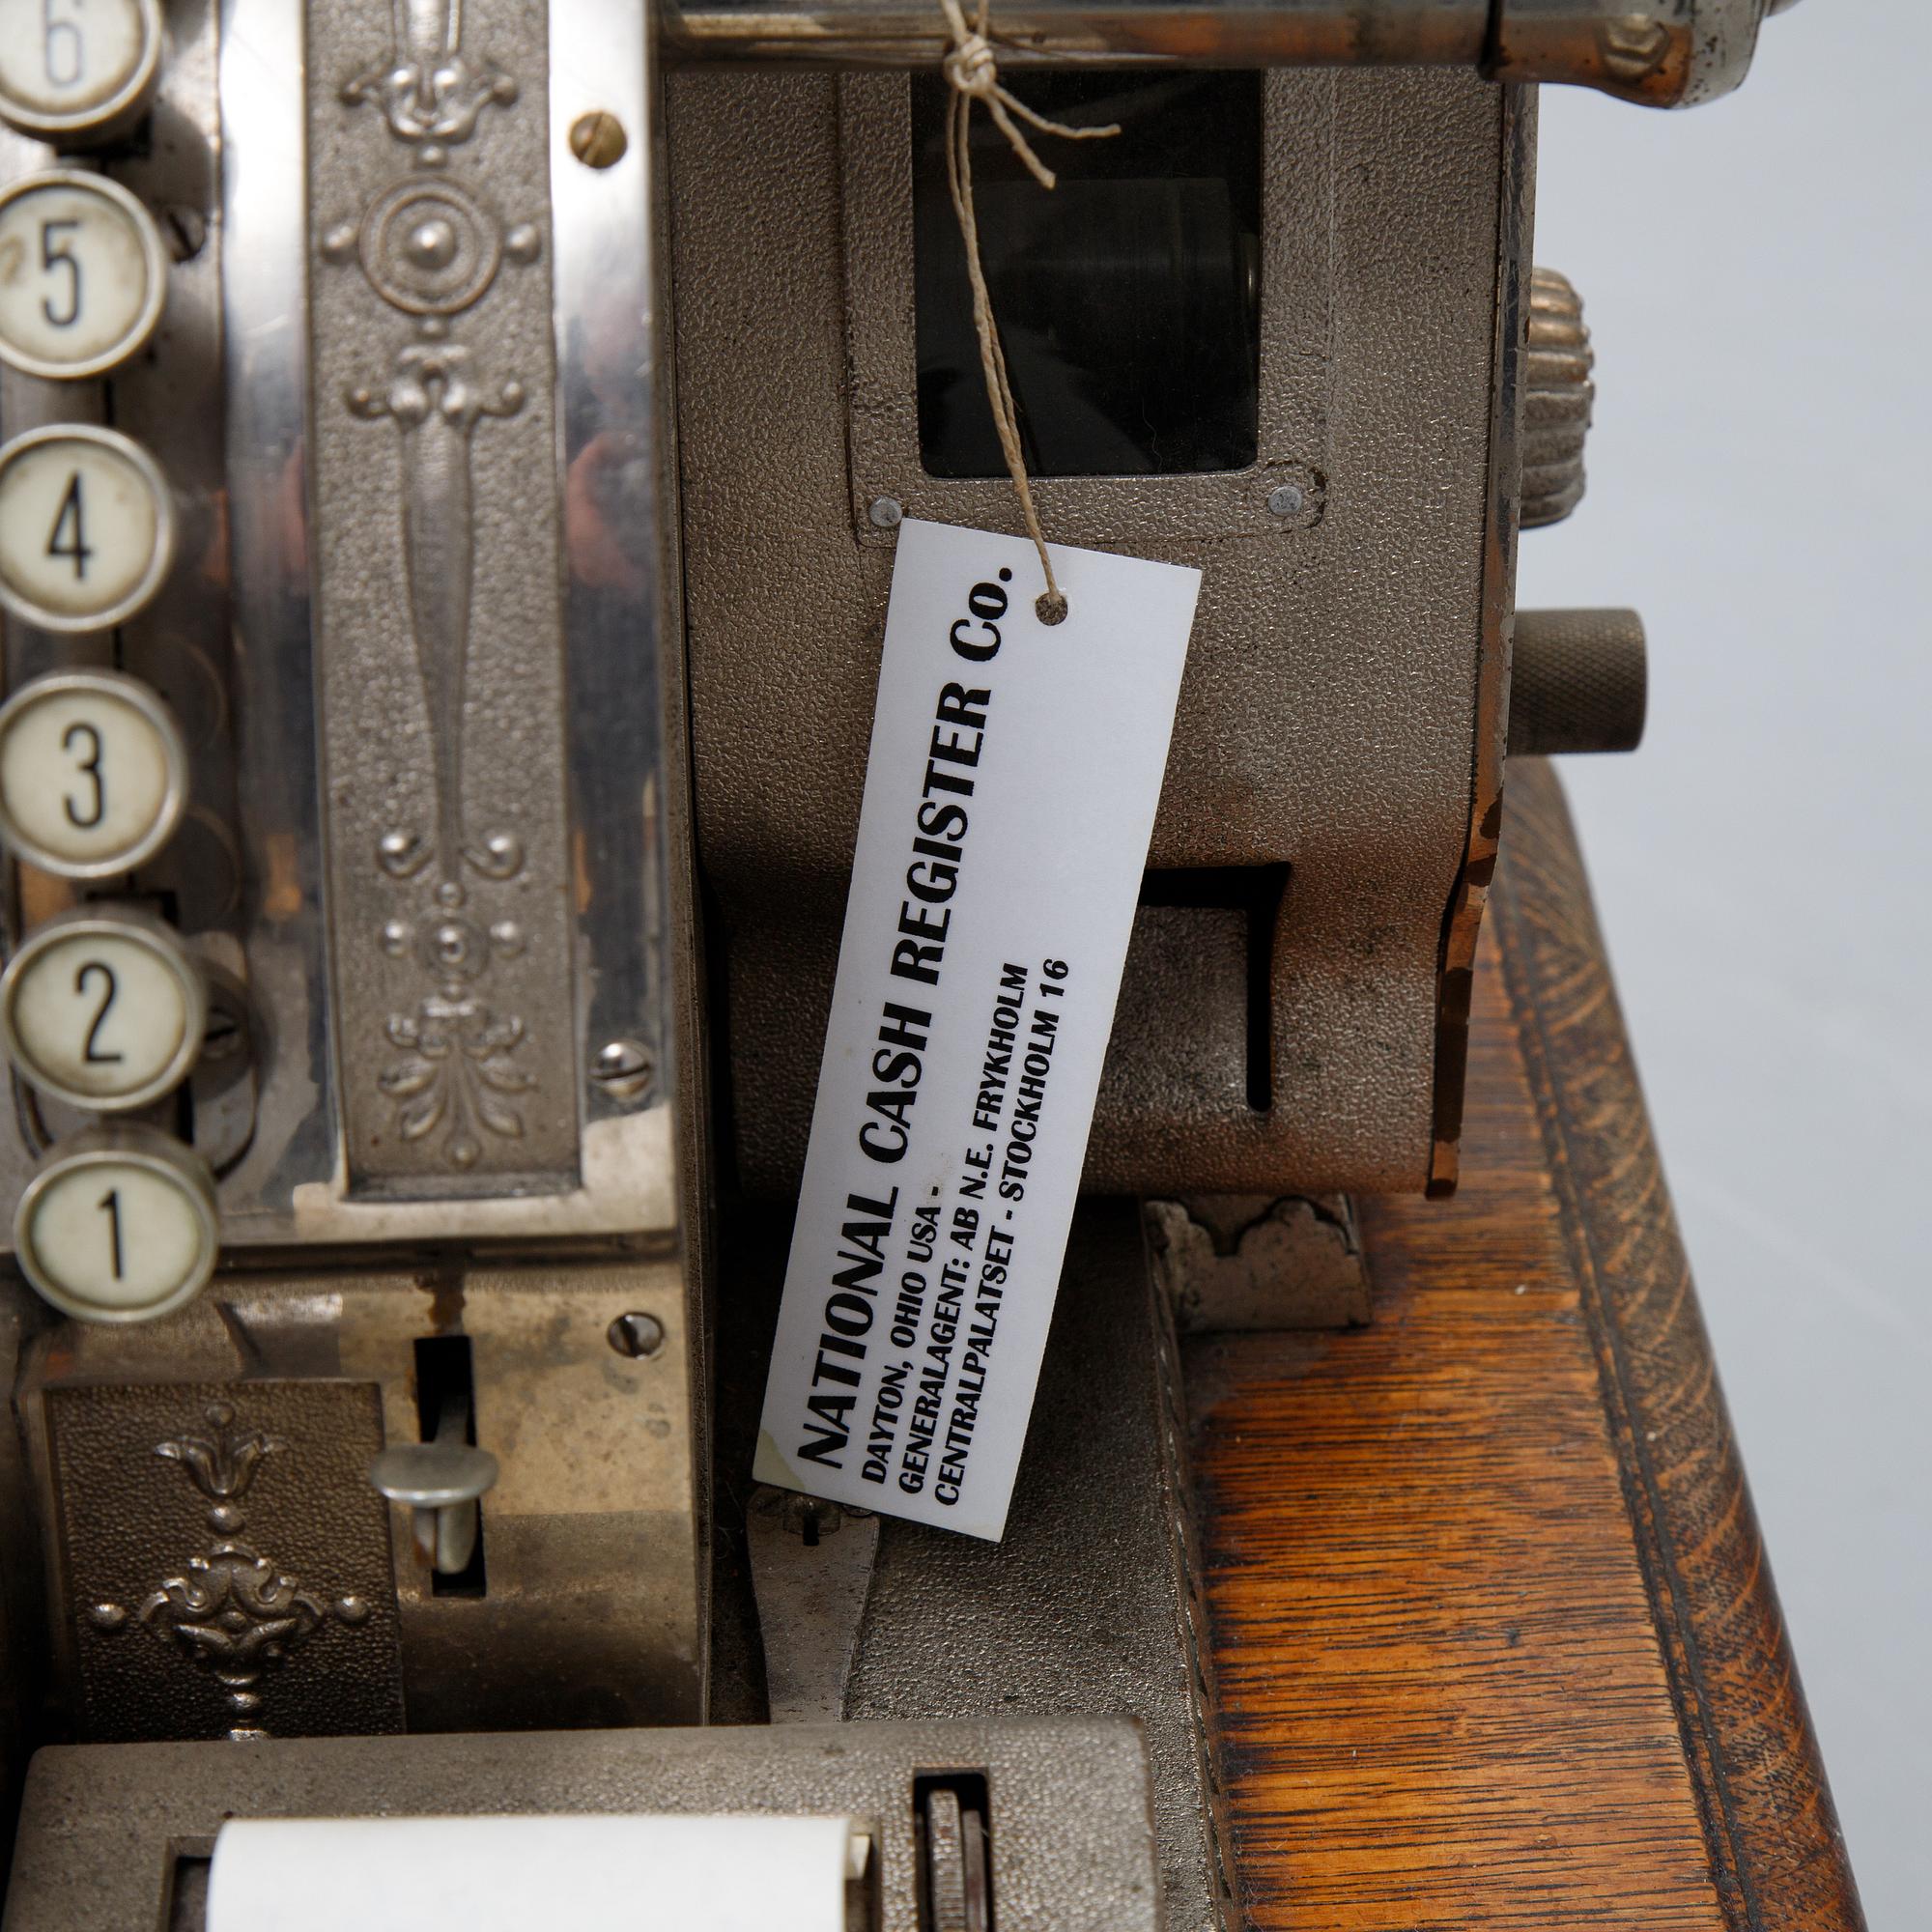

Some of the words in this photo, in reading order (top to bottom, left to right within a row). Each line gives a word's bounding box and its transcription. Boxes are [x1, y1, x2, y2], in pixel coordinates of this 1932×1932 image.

[43, 0, 85, 89] 6
[42, 219, 81, 327] 5
[44, 469, 93, 582] 4
[950, 568, 1012, 662] Co.
[62, 723, 105, 830] 3
[890, 682, 991, 985] REGISTER
[74, 961, 124, 1064] 2
[973, 963, 1028, 1131] FRYKHOLM
[859, 1002, 932, 1163] CASH
[959, 1144, 993, 1200] N.E.
[98, 1187, 124, 1281] 1
[907, 1207, 941, 1263] USA
[935, 1225, 1014, 1506] CENTRALPALATSET
[999, 1010, 1059, 1202] STOCKHOLM
[1039, 959, 1068, 997] 16
[951, 1208, 979, 1251] AB
[797, 1186, 898, 1469] NATIONAL
[890, 1272, 926, 1349] OHIO
[861, 1361, 914, 1485] DAYTON,
[898, 1259, 970, 1493] GENERALAGENT:
